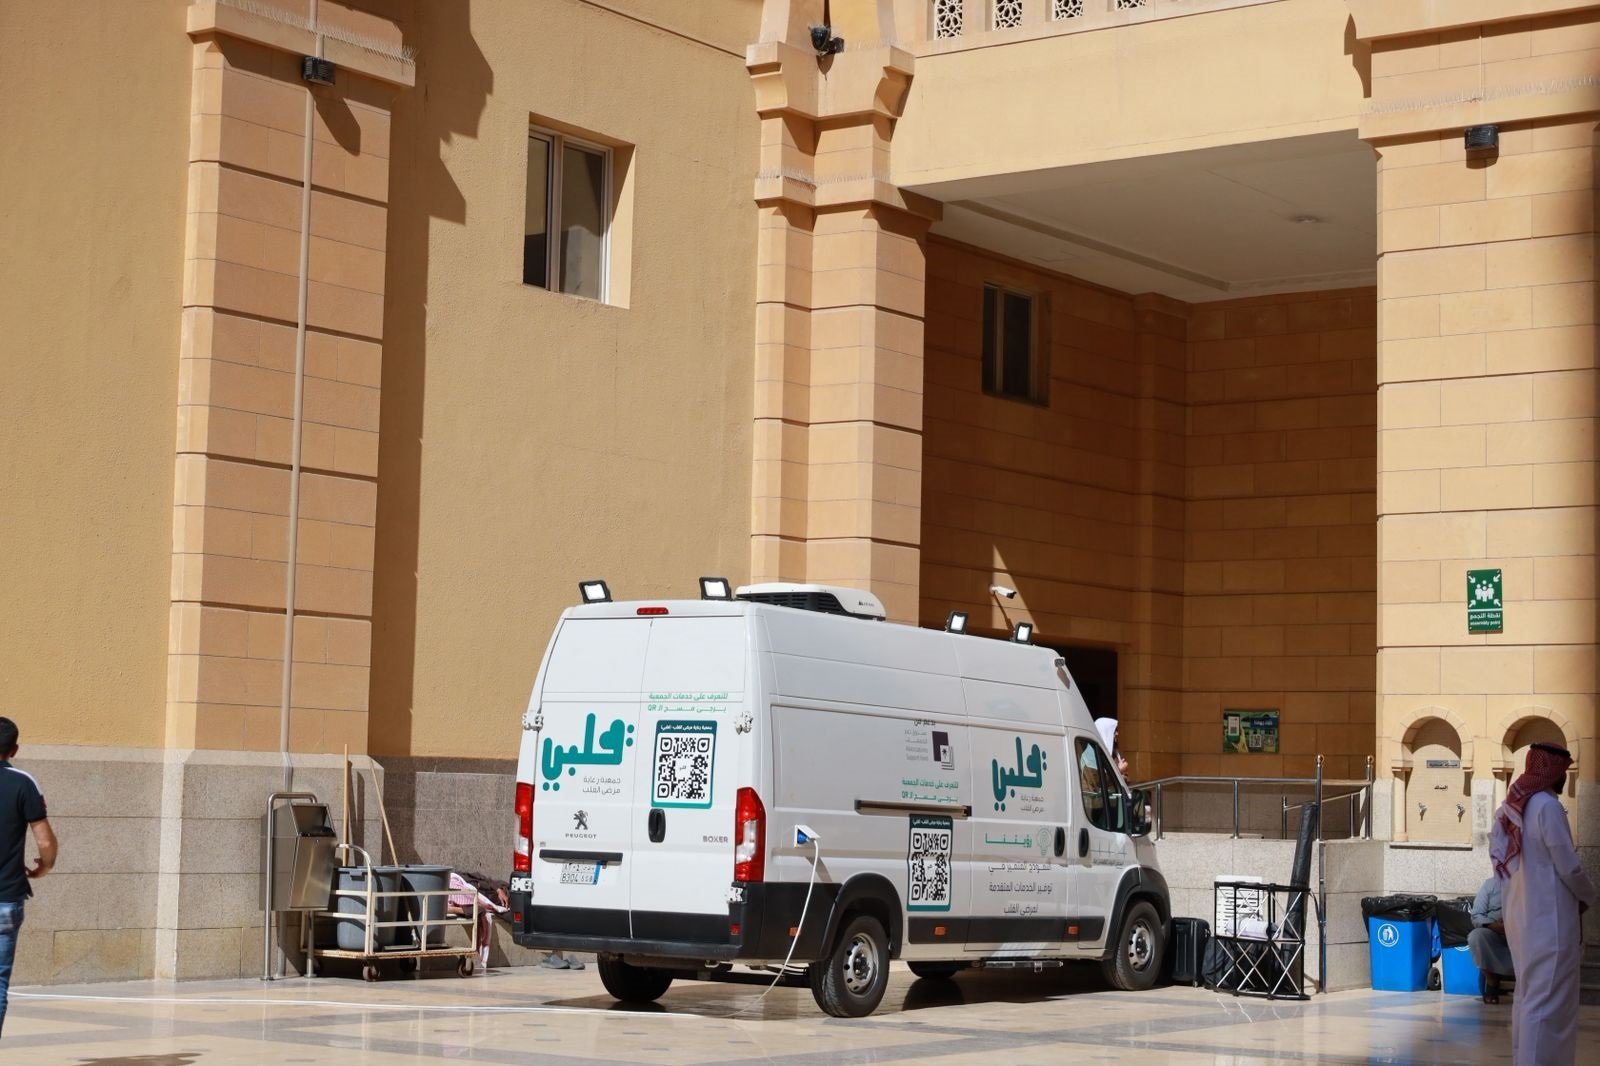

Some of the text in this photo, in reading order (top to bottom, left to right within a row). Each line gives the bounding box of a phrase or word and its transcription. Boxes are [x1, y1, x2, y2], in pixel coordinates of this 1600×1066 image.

[649, 691, 671, 700] الجمعية
[673, 692, 692, 700] خدمات
[707, 692, 728, 702] للتعرف
[647, 704, 657, 712] QR
[542, 713, 634, 791] قلبي
[992, 736, 1047, 812] قلبي
[703, 835, 728, 843] BOXER
